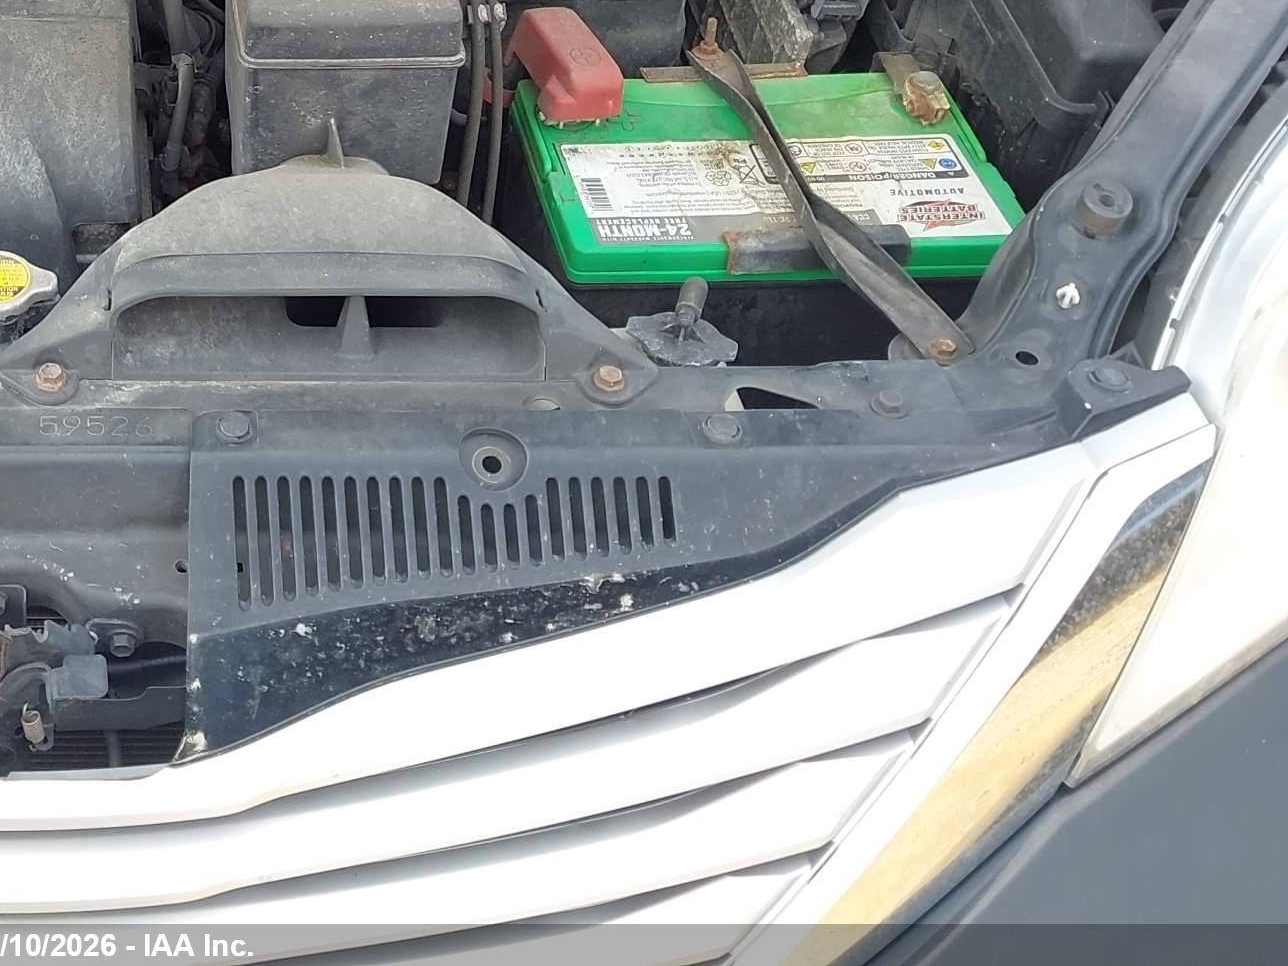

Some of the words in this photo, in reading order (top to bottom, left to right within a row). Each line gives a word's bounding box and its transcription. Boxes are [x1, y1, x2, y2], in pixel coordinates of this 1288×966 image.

[889, 187, 965, 196] AUTOMOTIVE
[901, 204, 977, 213] BATTERIES
[900, 211, 984, 222] INTERSTATE
[597, 223, 692, 237] 24-MONTH
[39, 415, 153, 437] 59526
